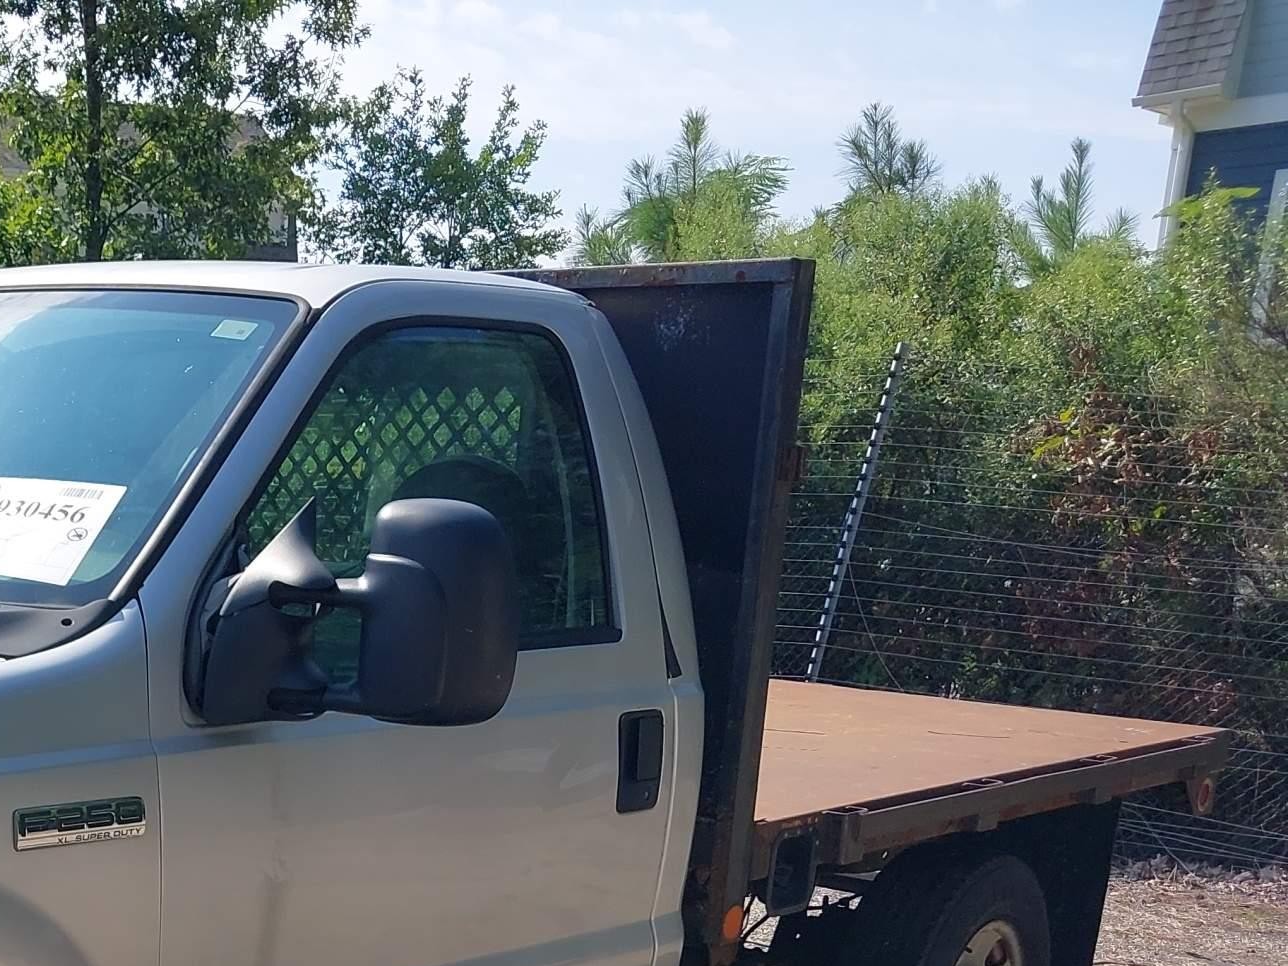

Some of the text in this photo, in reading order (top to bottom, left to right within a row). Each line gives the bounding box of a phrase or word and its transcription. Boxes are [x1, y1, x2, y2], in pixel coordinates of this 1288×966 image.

[56, 827, 142, 846] XL SUPER DUTY
